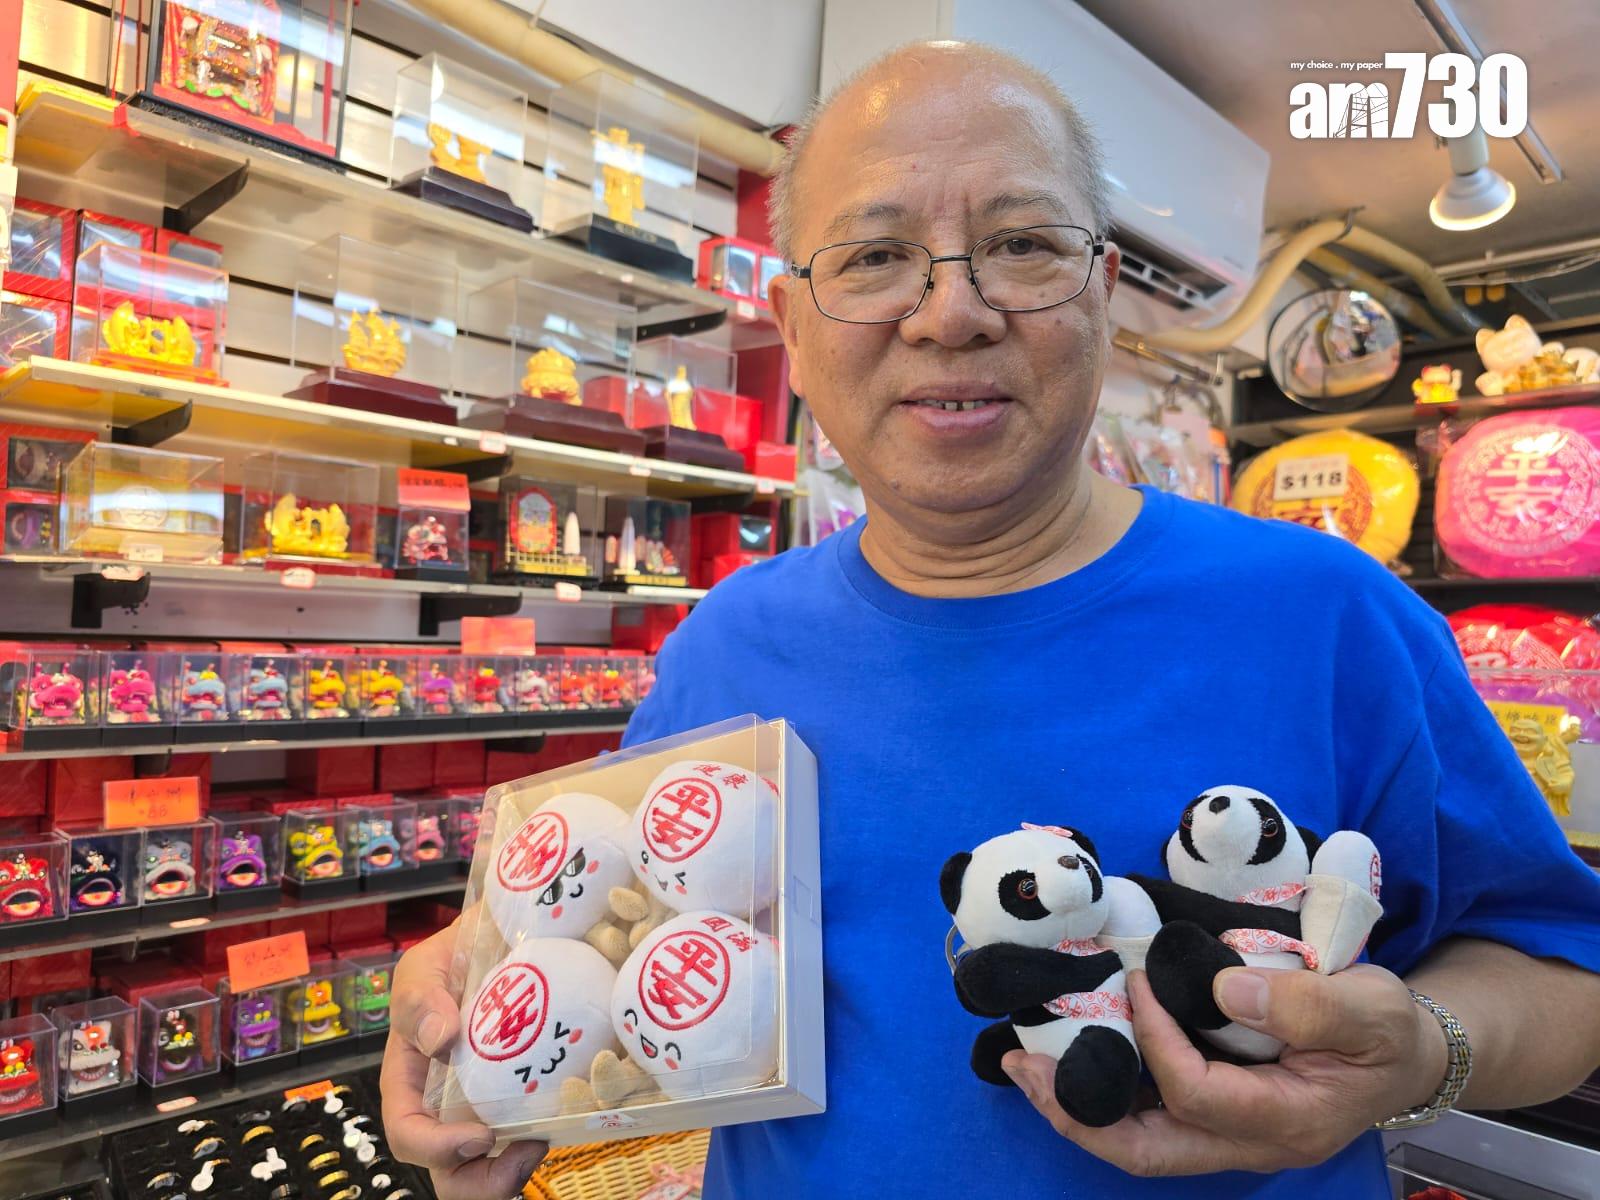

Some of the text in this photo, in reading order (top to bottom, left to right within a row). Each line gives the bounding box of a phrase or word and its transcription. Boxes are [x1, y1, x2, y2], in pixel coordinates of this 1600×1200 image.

[1281, 471, 1342, 490] $118
[503, 819, 559, 881] 平安
[651, 785, 711, 852] 平安
[475, 973, 538, 1050] 平安
[648, 938, 718, 1020] 平安
